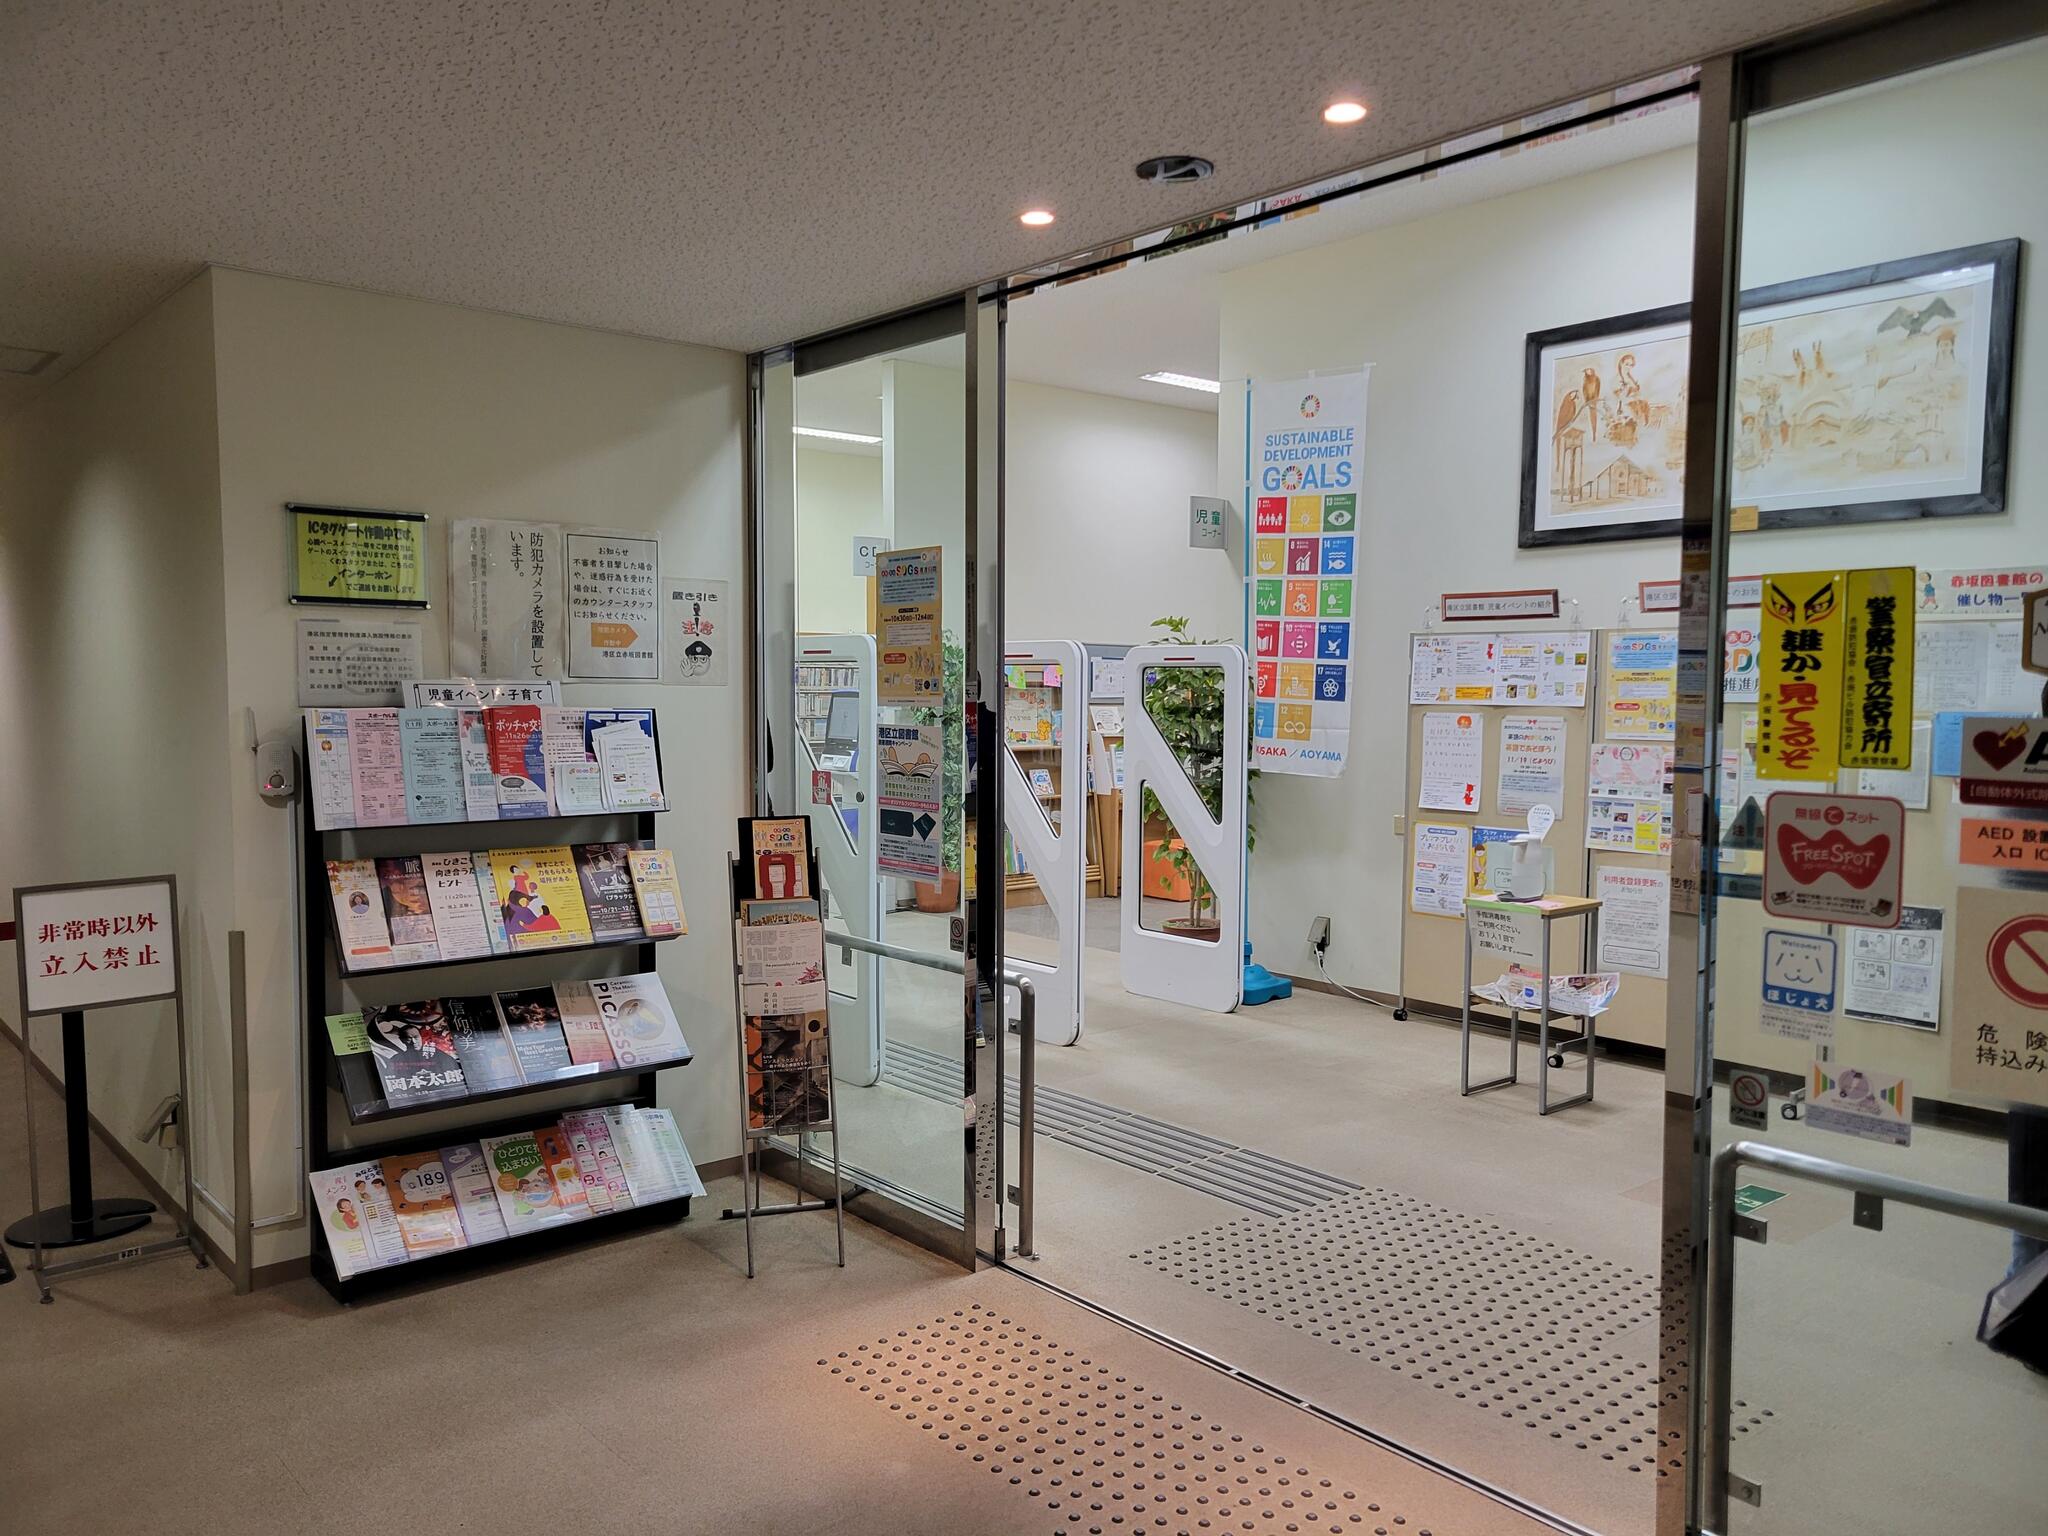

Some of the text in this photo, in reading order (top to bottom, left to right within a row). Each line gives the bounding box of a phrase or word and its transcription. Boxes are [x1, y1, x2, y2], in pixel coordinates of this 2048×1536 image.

[1265, 427, 1354, 447] SUSTAINABLE
[1264, 444, 1353, 462] DEVELOPMENT
[1263, 461, 1352, 491] GOALS
[1196, 509, 1220, 525] 児童
[510, 530, 525, 577] います。
[598, 547, 629, 557] お知らせ
[573, 559, 653, 571] 不審者を目撃した場合
[339, 568, 392, 580] インターホン
[574, 572, 653, 584] や、迷惑行為を受けた
[1951, 572, 2044, 587] 赤坂図書館の
[574, 586, 653, 596] 場合は、すぐにお近く
[672, 591, 718, 602] 置き引き
[530, 531, 545, 677] 防犯カメラを設置して
[573, 598, 653, 609] のカウンタースタッフ
[1957, 592, 2026, 607] 催し物一
[574, 611, 648, 622] にお知らせください。
[1631, 643, 1657, 651] SDGs
[1860, 596, 1897, 754] 警察官立寄所
[428, 687, 543, 701] 児童イベント・子育て
[1300, 750, 1342, 762] AOYAMA
[1795, 806, 1880, 825] 無線でネット
[770, 833, 795, 841] SDGs
[1977, 826, 2014, 840] AED
[1992, 846, 2023, 859] 入口
[439, 879, 462, 887] ヒント
[38, 912, 159, 943] 非常時以外
[1477, 921, 1521, 934] ご利用ください。
[1480, 940, 1518, 953] お願いします。
[39, 944, 161, 977] 立入禁止
[1767, 989, 1828, 1010] ほじょ犬
[593, 982, 636, 1065] PICASSO
[1976, 1045, 2048, 1073] 持込み
[385, 1069, 464, 1093] 岡本太郎
[416, 1171, 445, 1187] 189
